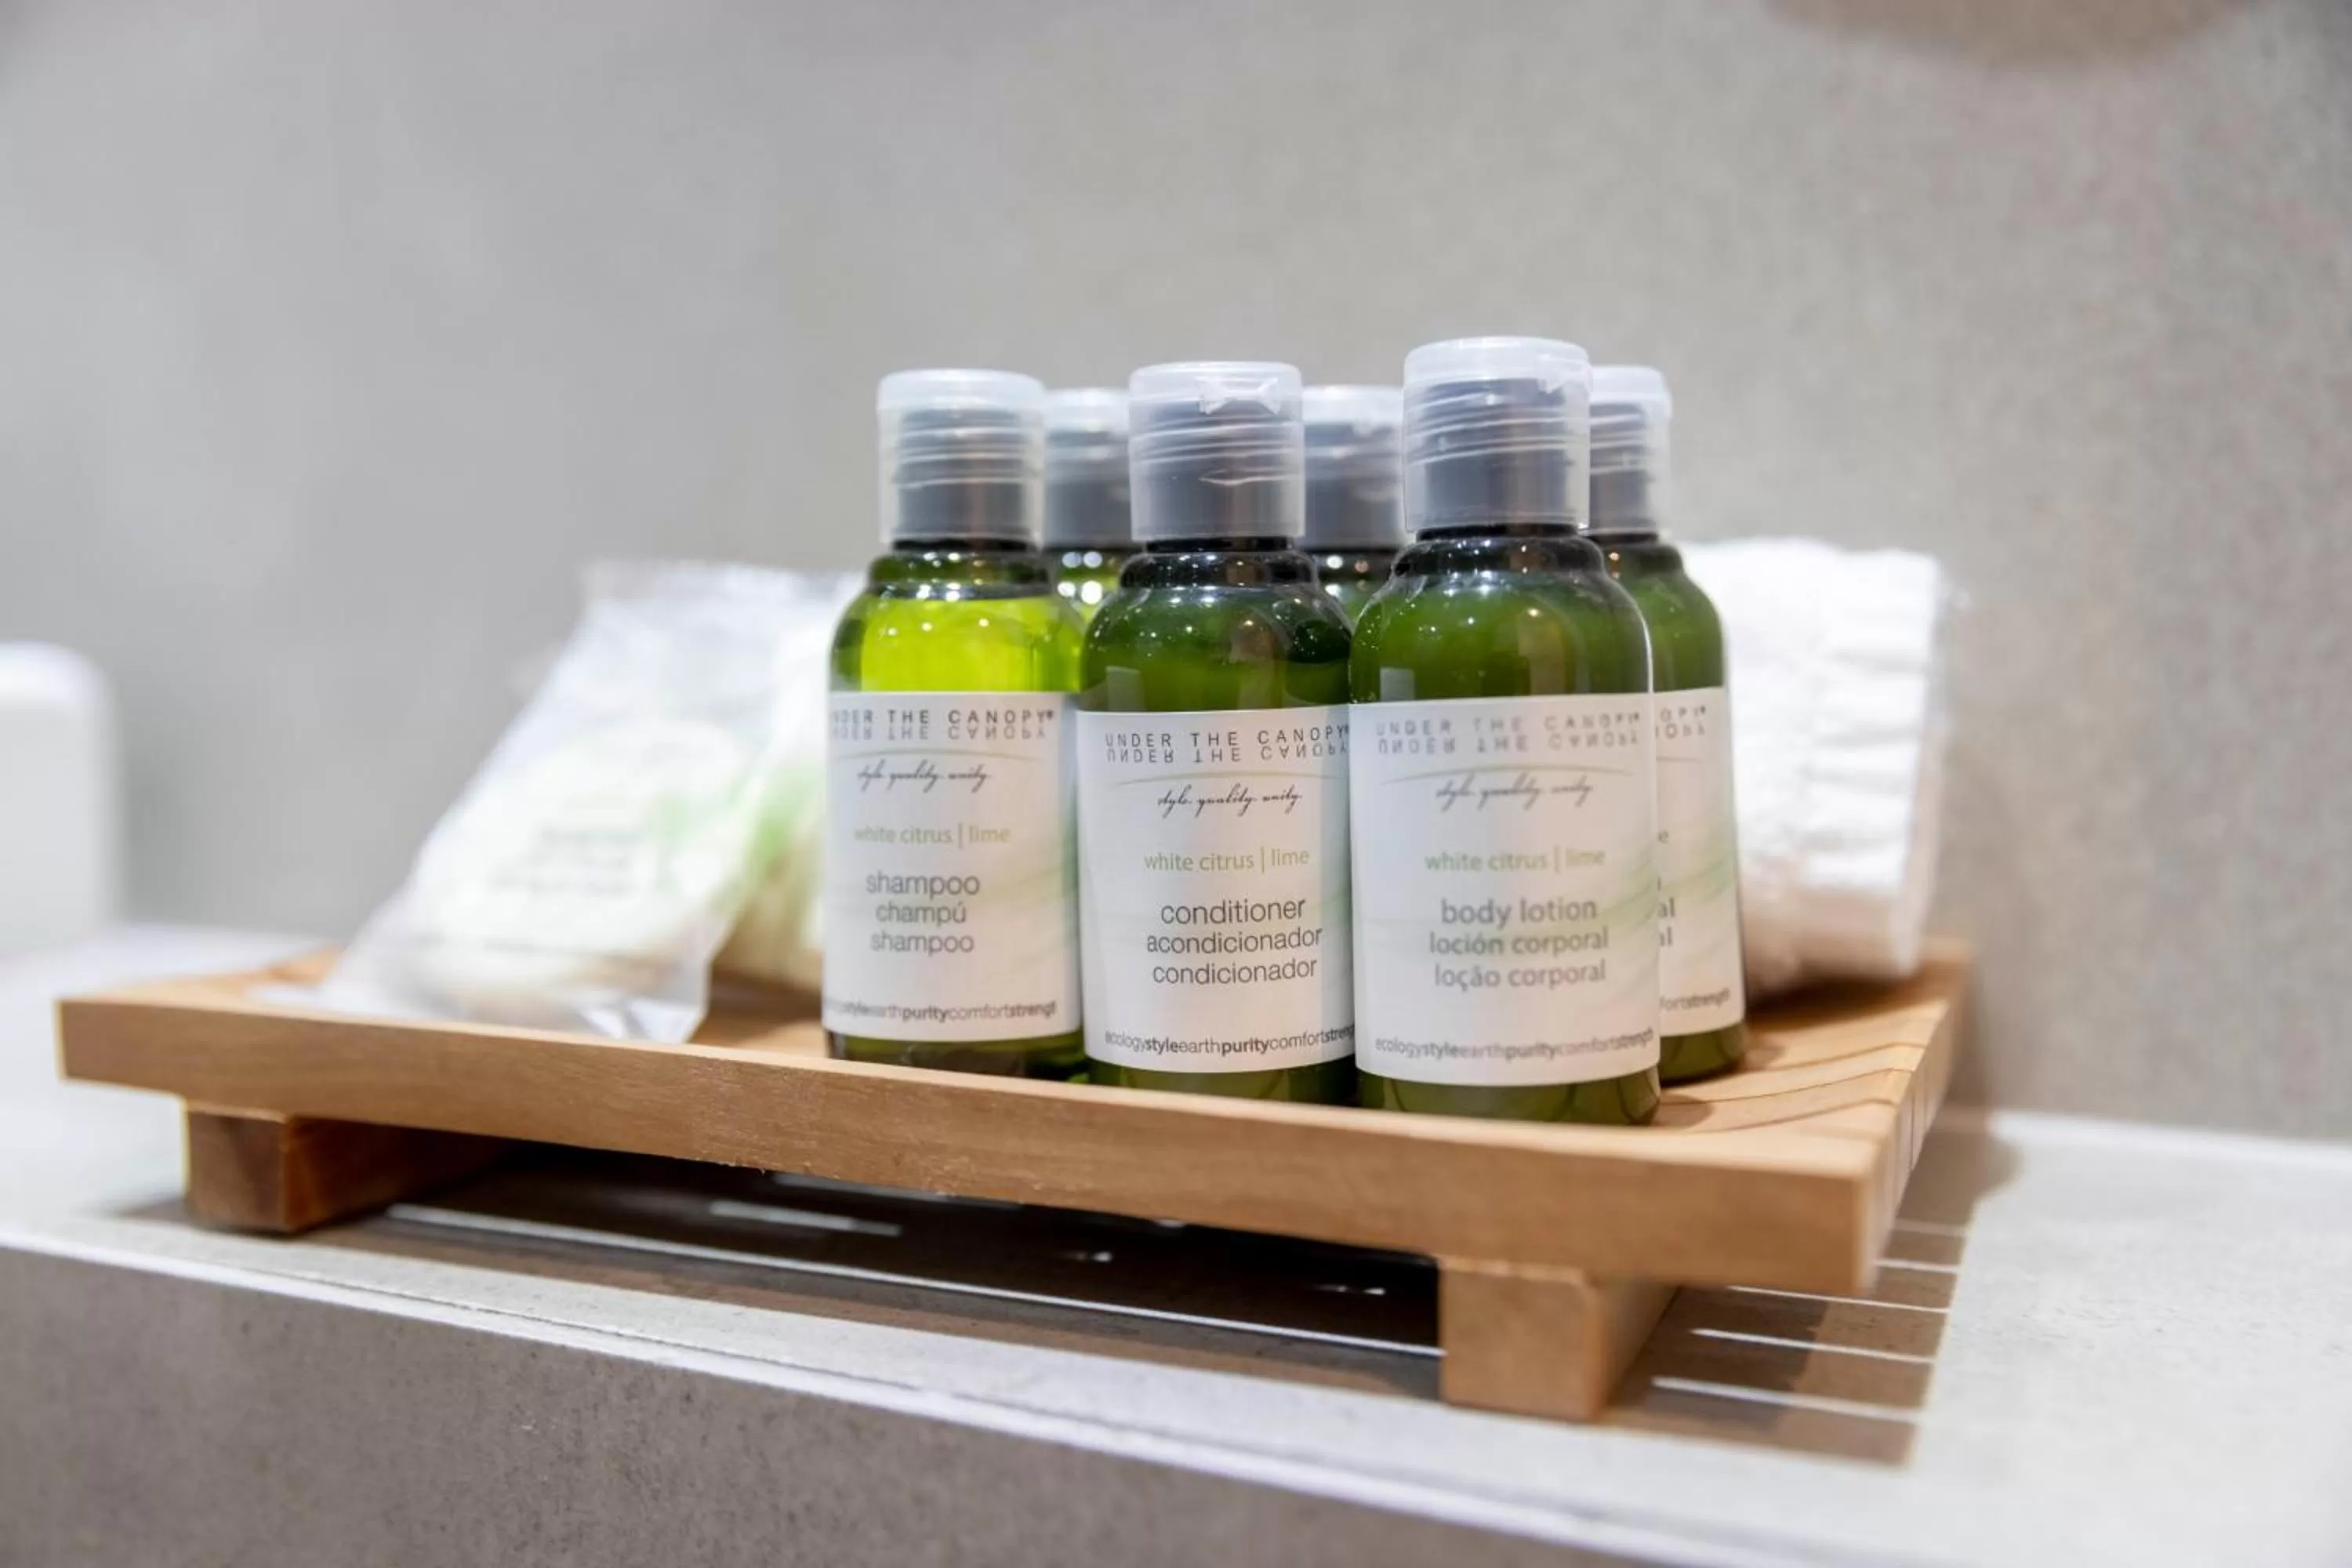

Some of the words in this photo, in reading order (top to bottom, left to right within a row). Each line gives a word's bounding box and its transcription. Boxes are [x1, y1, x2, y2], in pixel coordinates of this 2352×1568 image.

[887, 708, 929, 724] THE
[1105, 732, 1173, 747] UNDER
[1191, 731, 1239, 747] THE
[854, 825, 896, 843] white
[899, 825, 953, 843] citrus
[968, 825, 1011, 843] lime
[1144, 852, 1194, 872] white
[1199, 849, 1254, 872] citrus
[1271, 848, 1310, 867] lime
[1425, 851, 1483, 872] white
[1488, 850, 1548, 872] citrus
[1566, 846, 1606, 866] lime
[866, 870, 981, 900] shampoo
[875, 901, 967, 927] champú
[1161, 898, 1306, 925] conditioner
[1441, 898, 1512, 928] body
[1520, 898, 1599, 924] lotion
[870, 931, 975, 956] shampoo
[1147, 927, 1323, 955] acondicionador
[1429, 931, 1504, 955] loción
[1511, 927, 1609, 957] corporal
[1153, 957, 1318, 985] condicionador
[1434, 963, 1501, 993] loção
[1508, 959, 1606, 990] corporal
